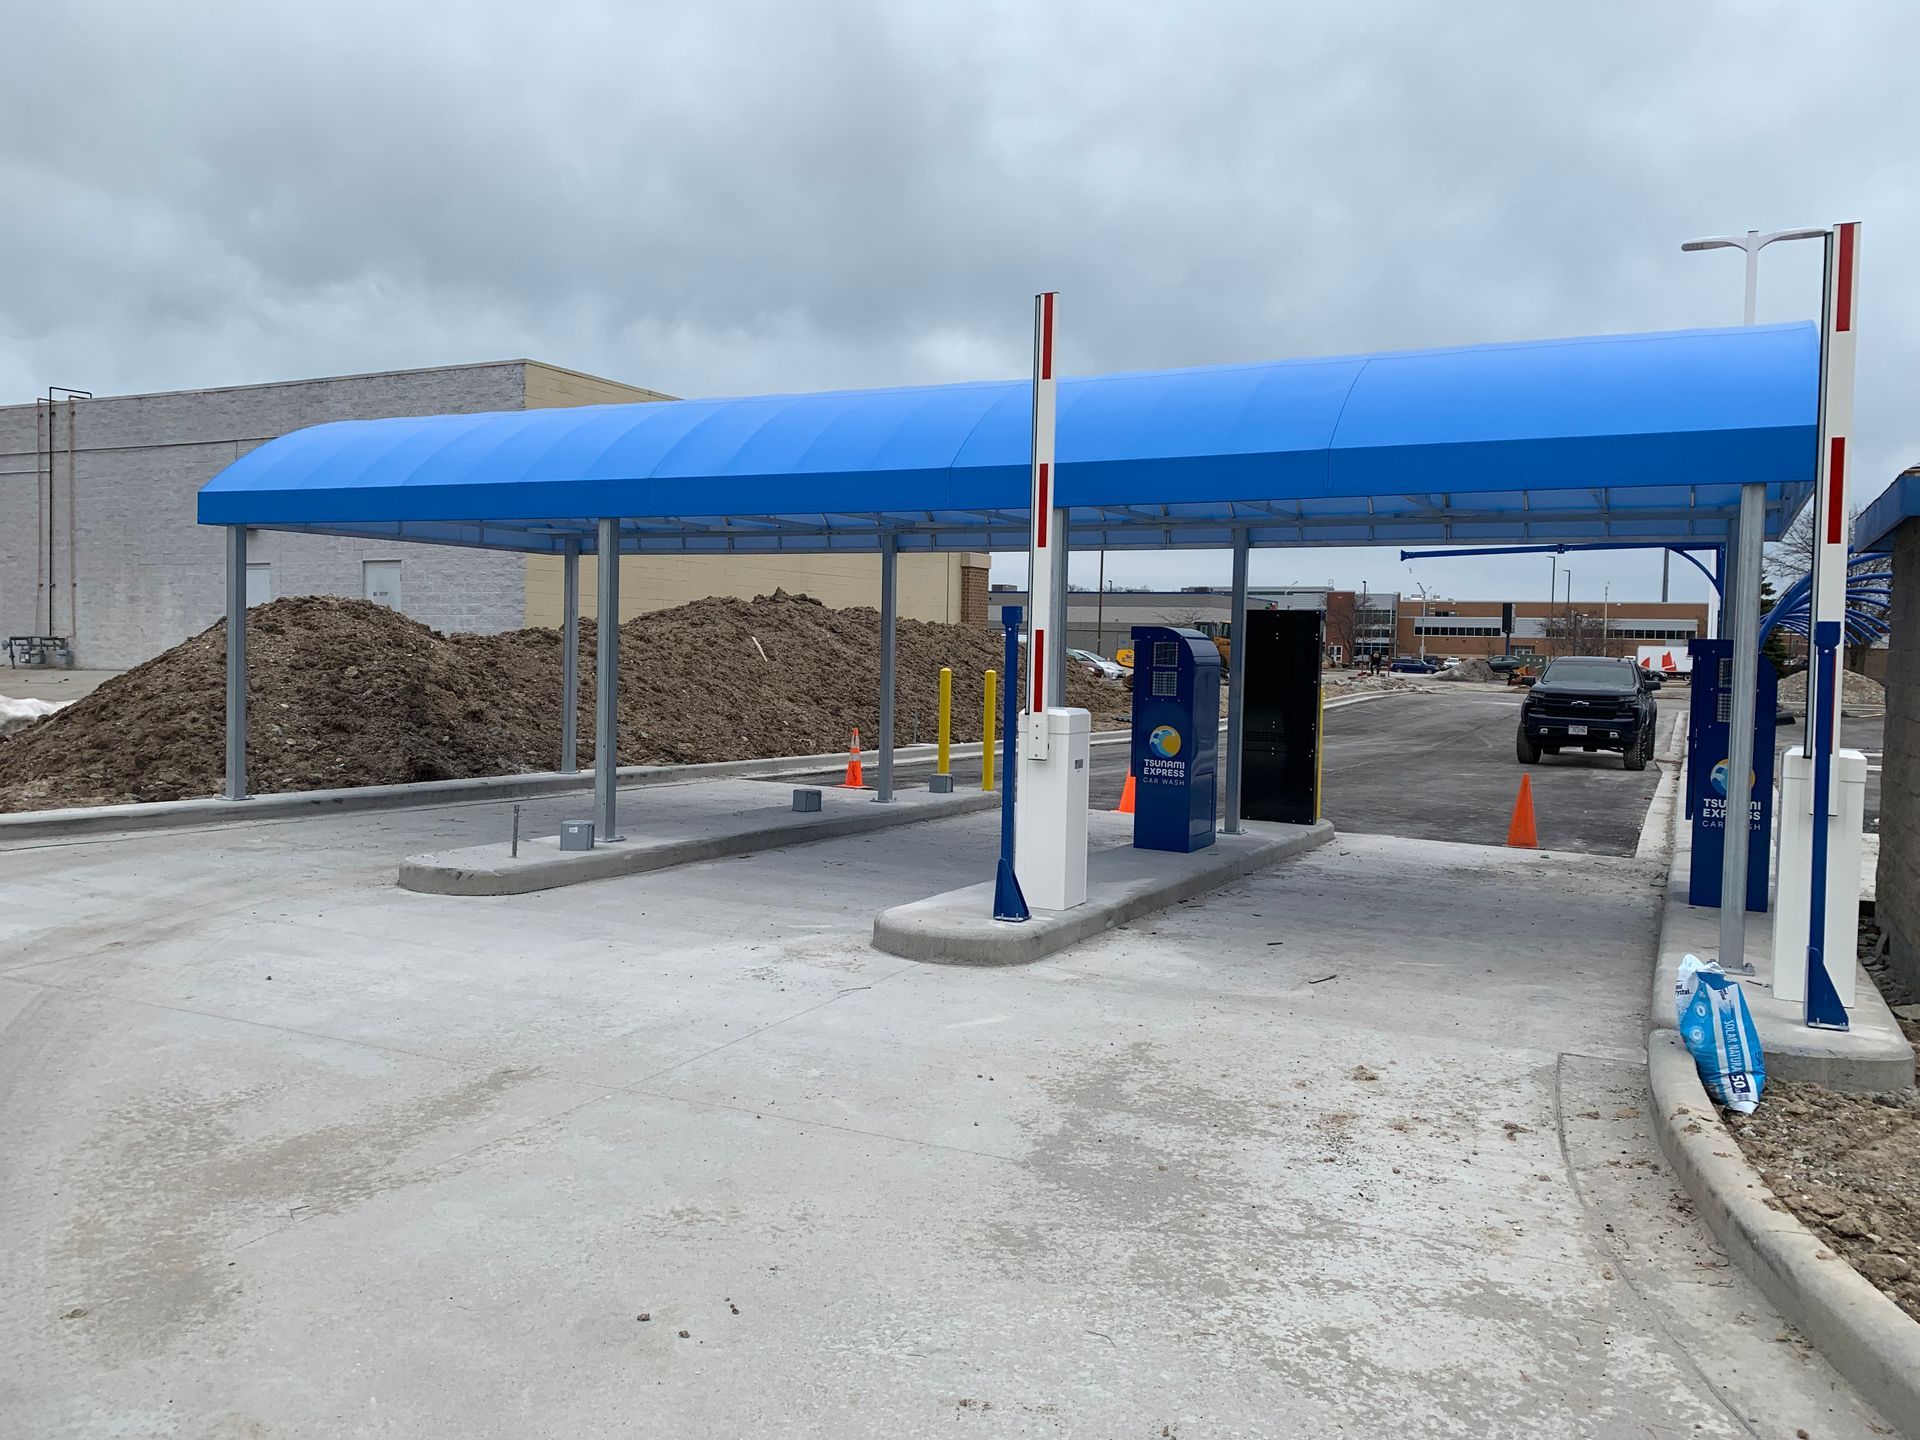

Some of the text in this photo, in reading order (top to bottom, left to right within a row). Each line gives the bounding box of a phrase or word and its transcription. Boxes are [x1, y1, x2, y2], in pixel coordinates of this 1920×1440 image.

[1144, 758, 1185, 769] TSUNAMI
[1144, 767, 1184, 778] EXPRESS
[1702, 808, 1761, 820] EXPS
[1702, 820, 1724, 828] CAR
[1723, 1020, 1738, 1043] SOLAR
[1731, 1074, 1747, 1088] 50
